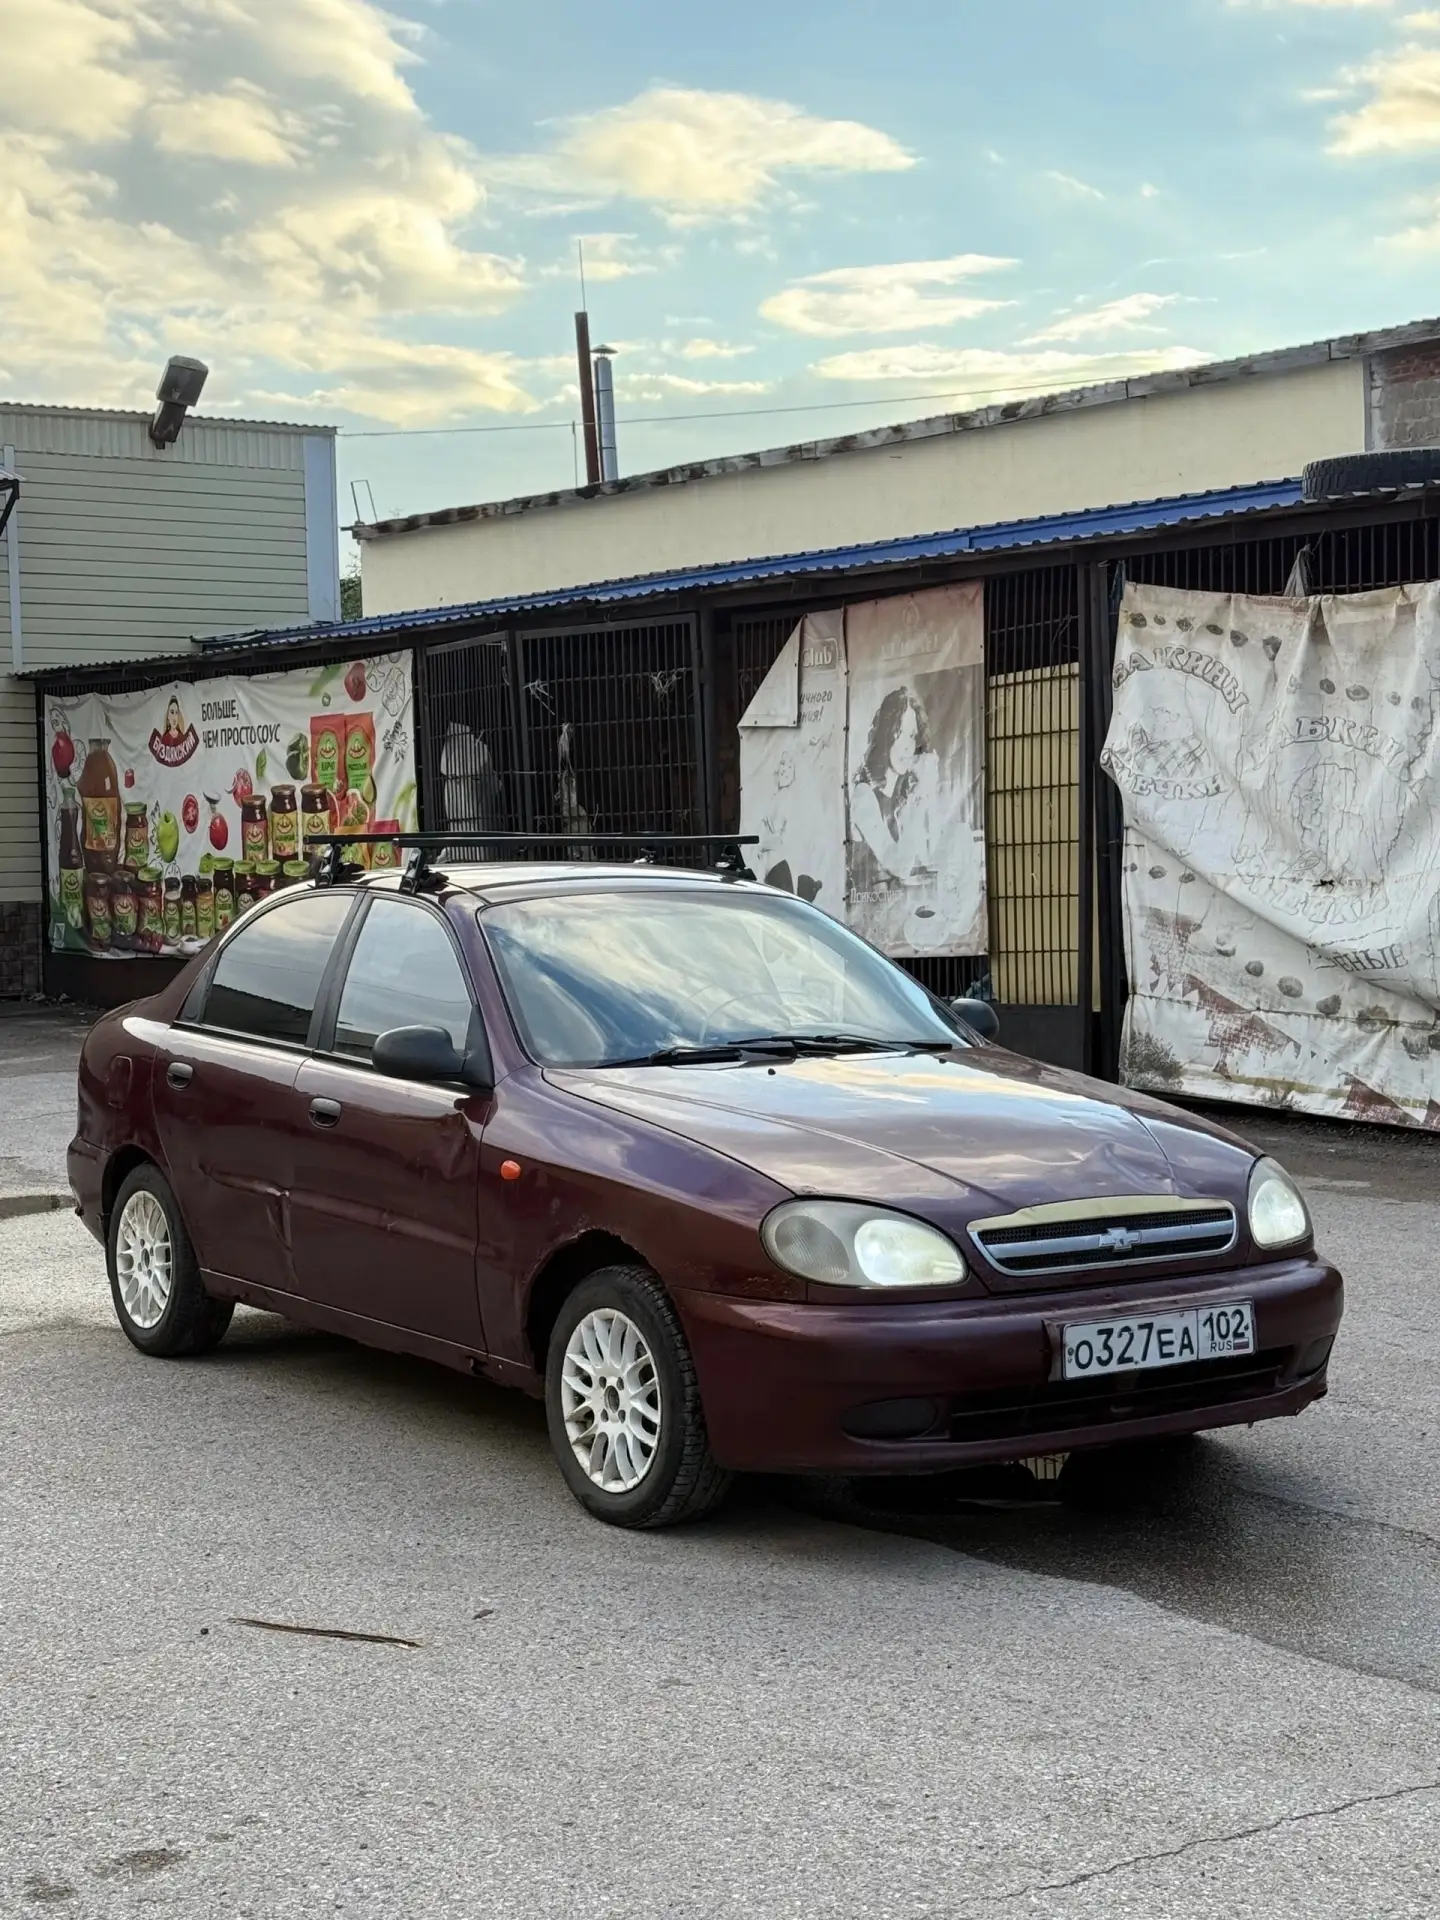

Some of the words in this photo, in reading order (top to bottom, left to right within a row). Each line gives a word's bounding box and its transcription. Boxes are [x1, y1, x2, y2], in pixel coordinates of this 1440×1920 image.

[802, 646, 833, 668] Club
[201, 699, 240, 722] БОЛЬШЕ,
[202, 730, 219, 749] ЧЕМ
[1332, 943, 1409, 973] ЕНЫЕ
[1202, 1308, 1246, 1341] 102
[1209, 1339, 1233, 1353] RUS
